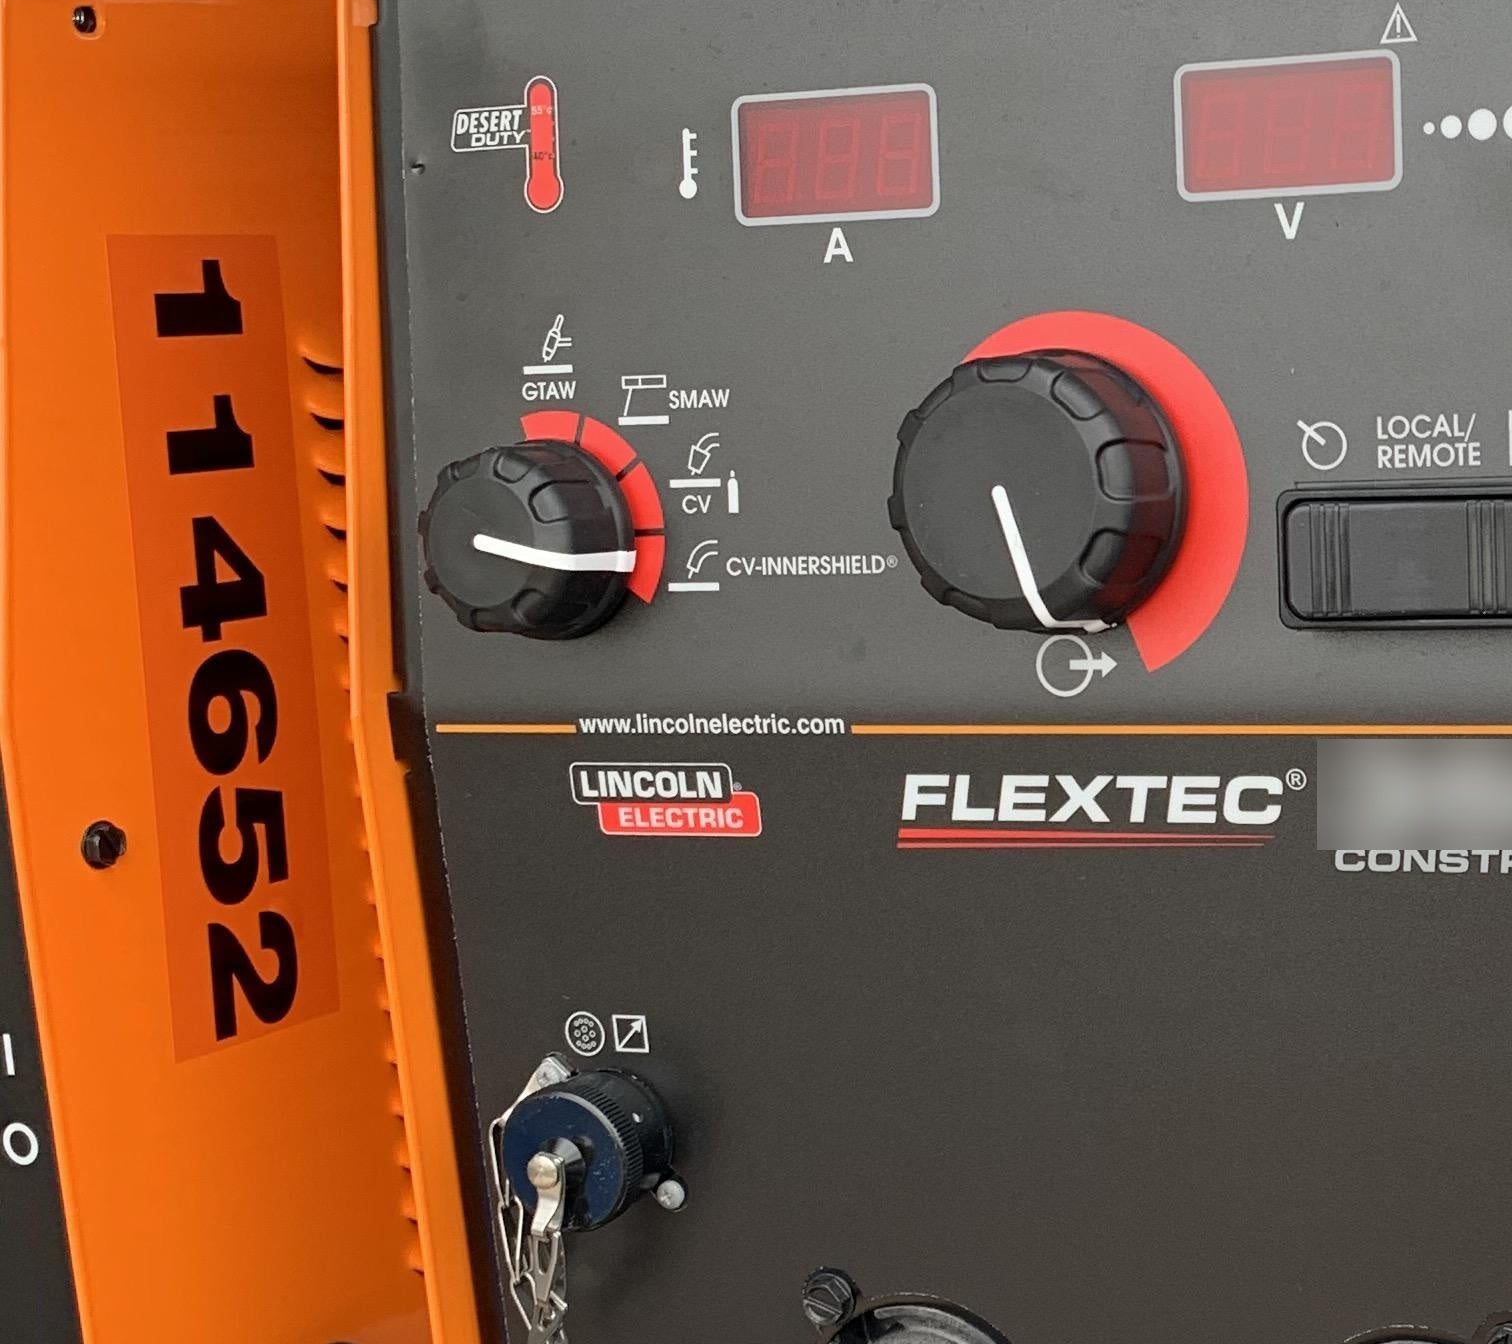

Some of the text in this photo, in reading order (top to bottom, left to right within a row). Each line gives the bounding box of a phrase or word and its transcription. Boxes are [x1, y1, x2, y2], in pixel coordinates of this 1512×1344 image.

[456, 109, 523, 135] DESERT
[1274, 202, 1304, 240] V
[823, 227, 854, 264] A
[521, 381, 577, 401] GTAW
[668, 389, 730, 409] SMAW
[1376, 413, 1476, 442] LOCAL/
[1378, 442, 1482, 469] REMOTE
[682, 494, 711, 515] CV
[578, 713, 846, 735] www.lincolnelectric.com
[618, 806, 744, 830] ELECTRIC
